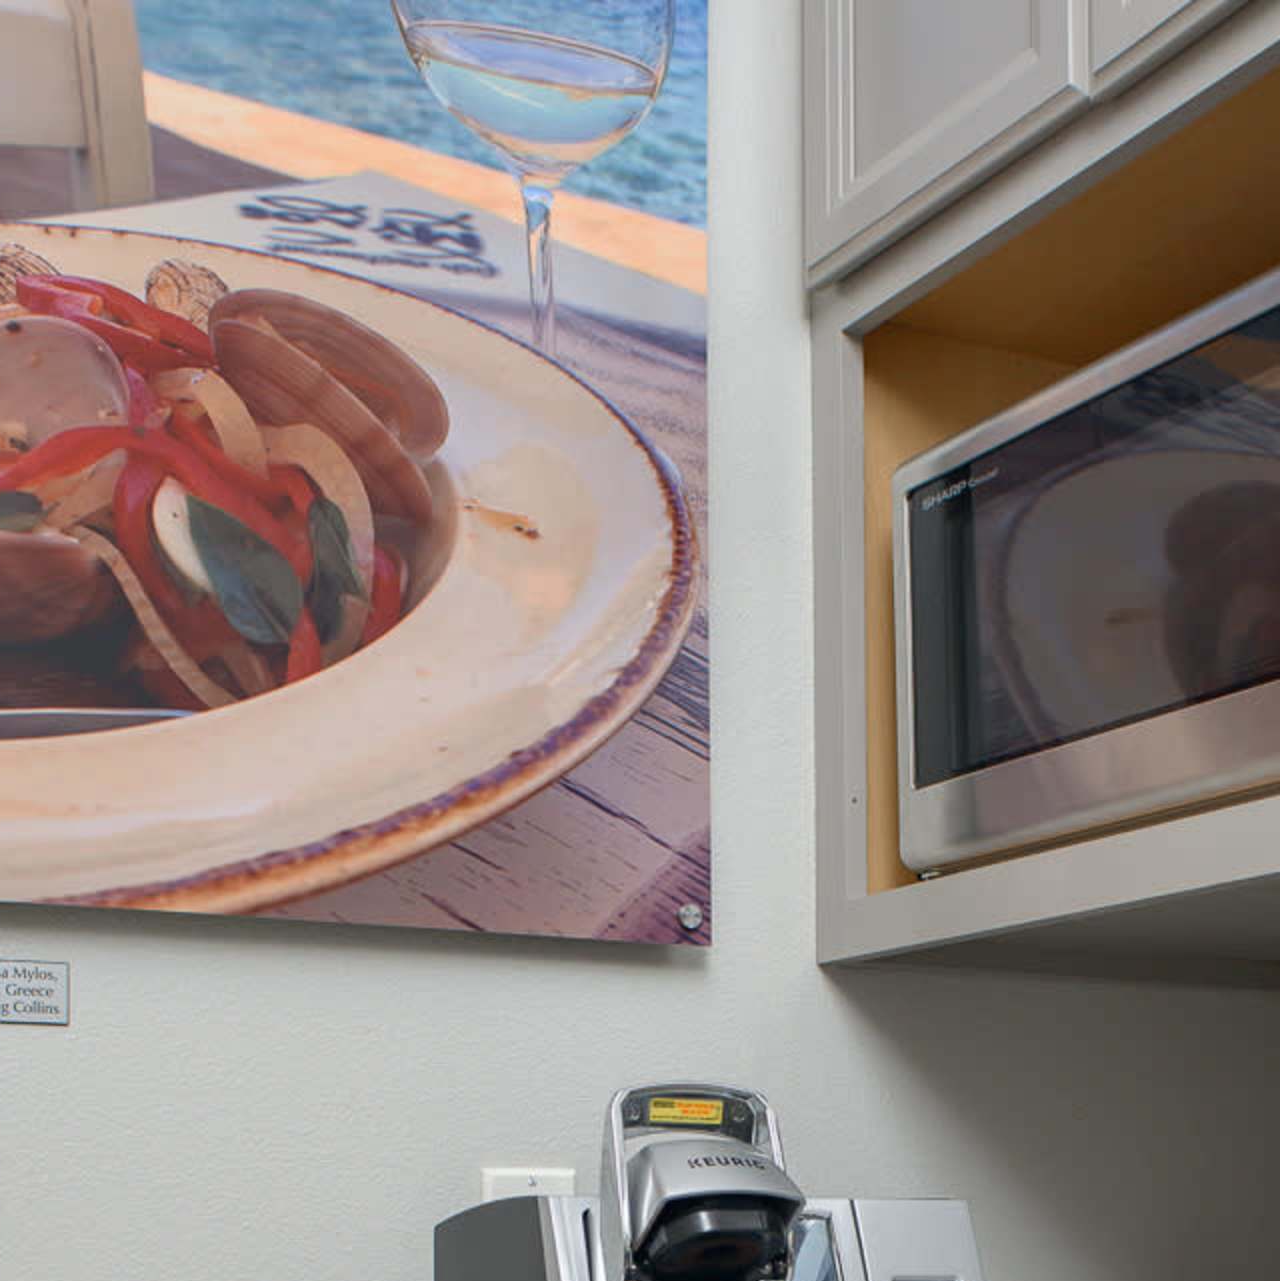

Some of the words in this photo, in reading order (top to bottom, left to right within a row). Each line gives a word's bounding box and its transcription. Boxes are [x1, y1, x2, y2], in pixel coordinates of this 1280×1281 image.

[13, 966, 58, 983] Mylos,
[5, 983, 54, 998] Greece
[13, 1000, 60, 1015] Collins
[687, 1154, 766, 1170] KEURIG
